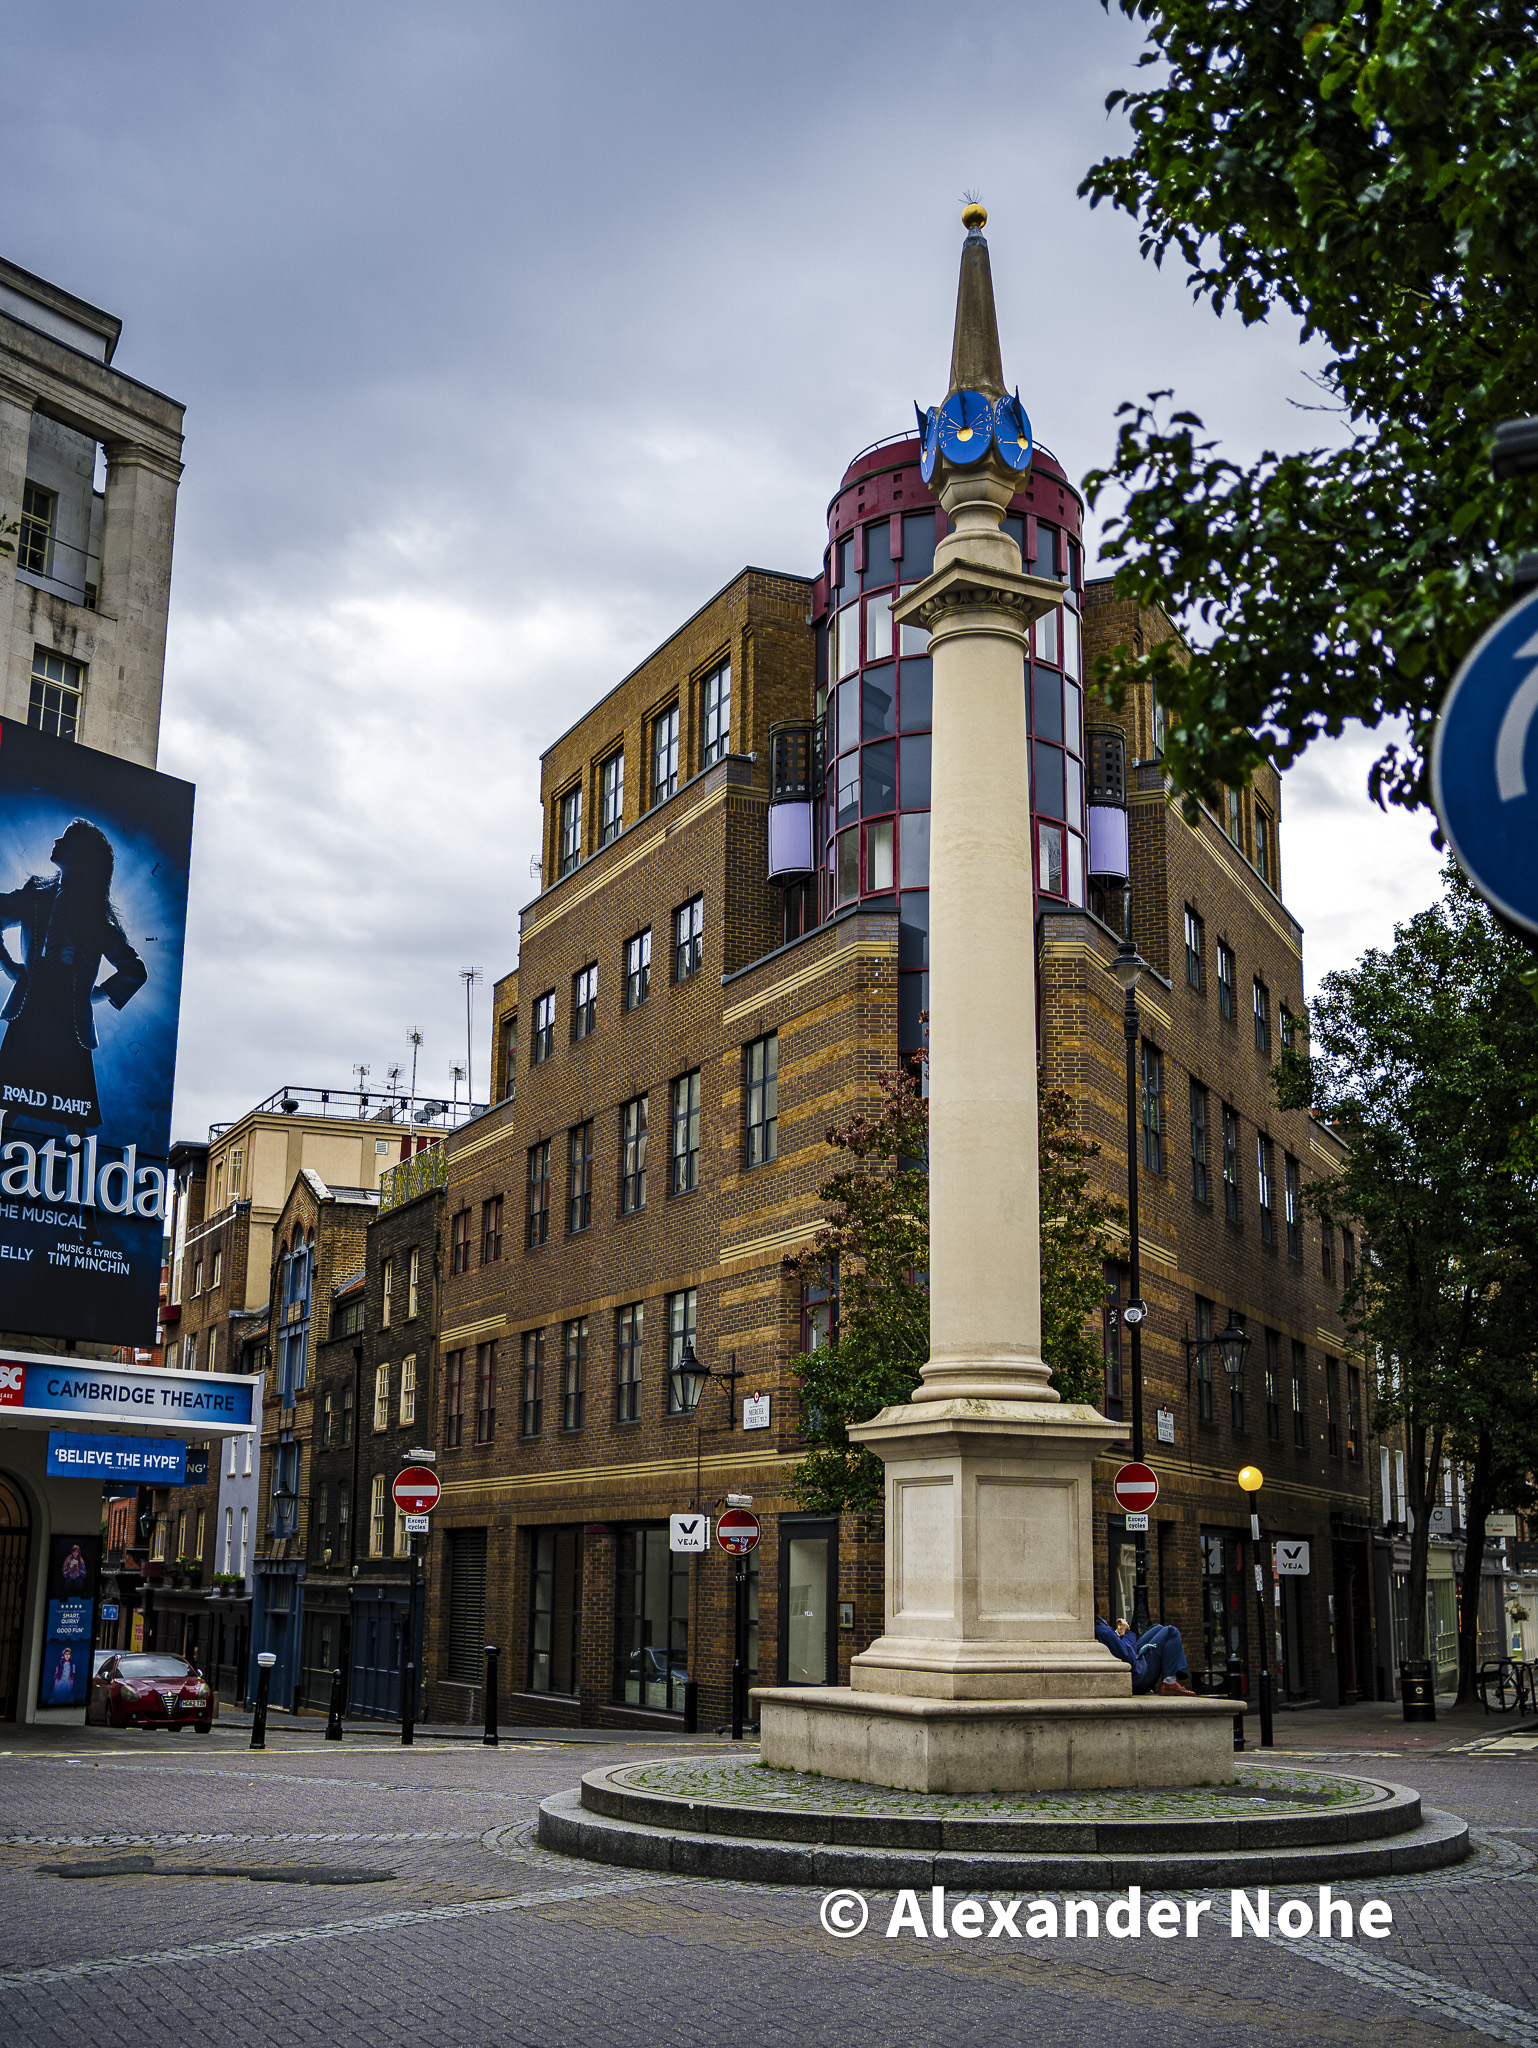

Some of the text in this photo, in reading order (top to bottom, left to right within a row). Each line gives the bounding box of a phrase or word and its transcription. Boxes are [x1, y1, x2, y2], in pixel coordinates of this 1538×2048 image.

[985, 413, 992, 421] 5
[938, 420, 945, 428] 7
[985, 423, 993, 431] 6
[938, 430, 945, 438] 6
[983, 433, 991, 442] 7
[940, 440, 947, 448] 5
[2, 1084, 92, 1116] ROALD DAHL'S
[0, 1109, 168, 1221] atilda
[22, 1206, 87, 1230] MUSICAL
[0, 1244, 34, 1261] ELLY
[57, 1242, 123, 1260] MUSIC & LYRICS
[47, 1251, 130, 1275] TIM MINCHIN
[46, 1379, 235, 1412] CAMBRIDGE THEATRE
[115, 1452, 141, 1467] THE
[677, 1538, 699, 1546] VEJA
[1282, 1562, 1303, 1570] VEJA
